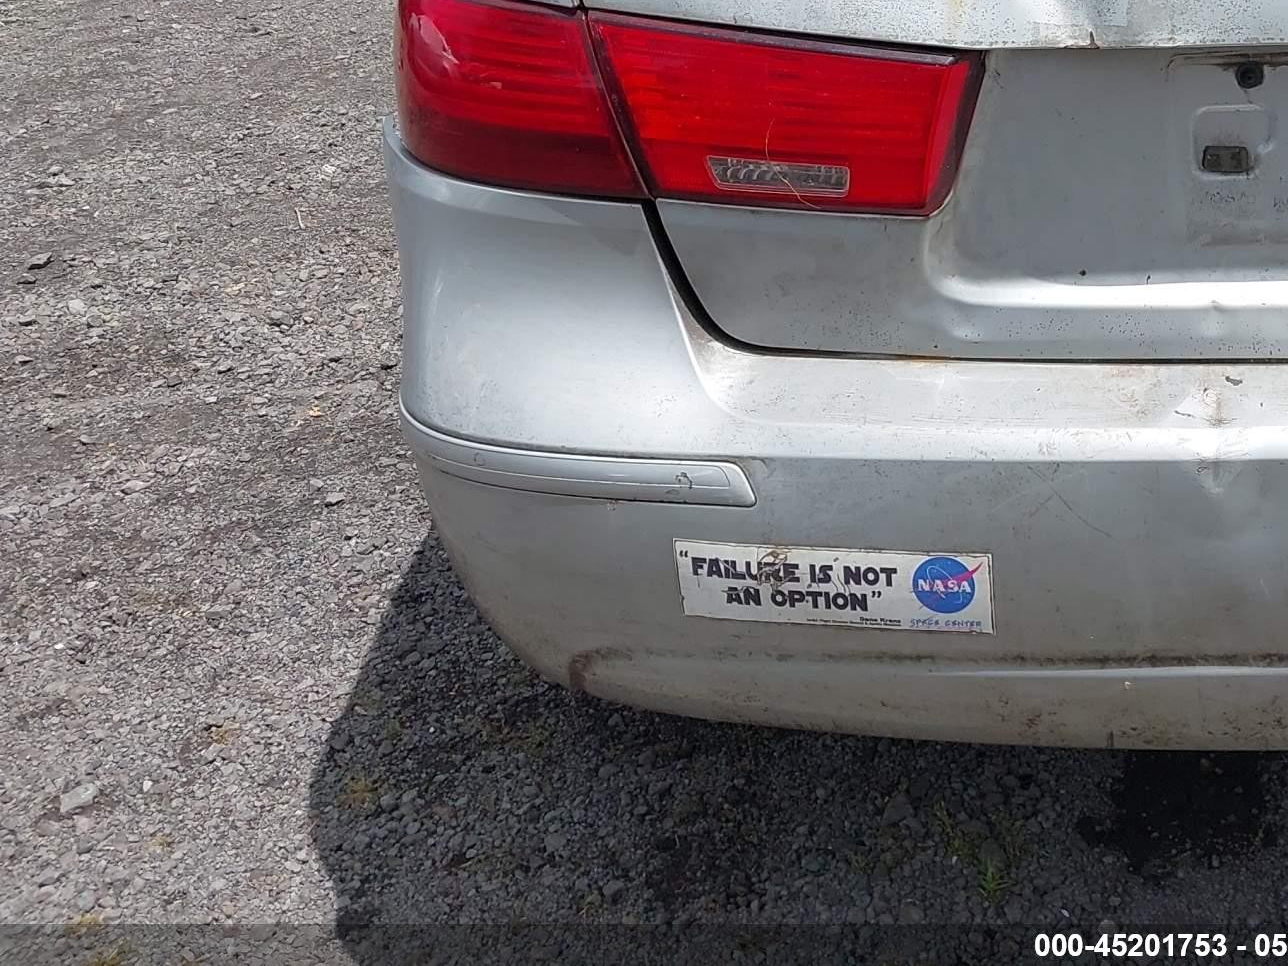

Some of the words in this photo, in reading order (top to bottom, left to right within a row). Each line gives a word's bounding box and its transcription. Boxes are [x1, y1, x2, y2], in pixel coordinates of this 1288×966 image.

[809, 564, 833, 584] IS
[843, 565, 898, 587] NOT
[917, 578, 972, 594] NASA
[726, 586, 762, 607] AN
